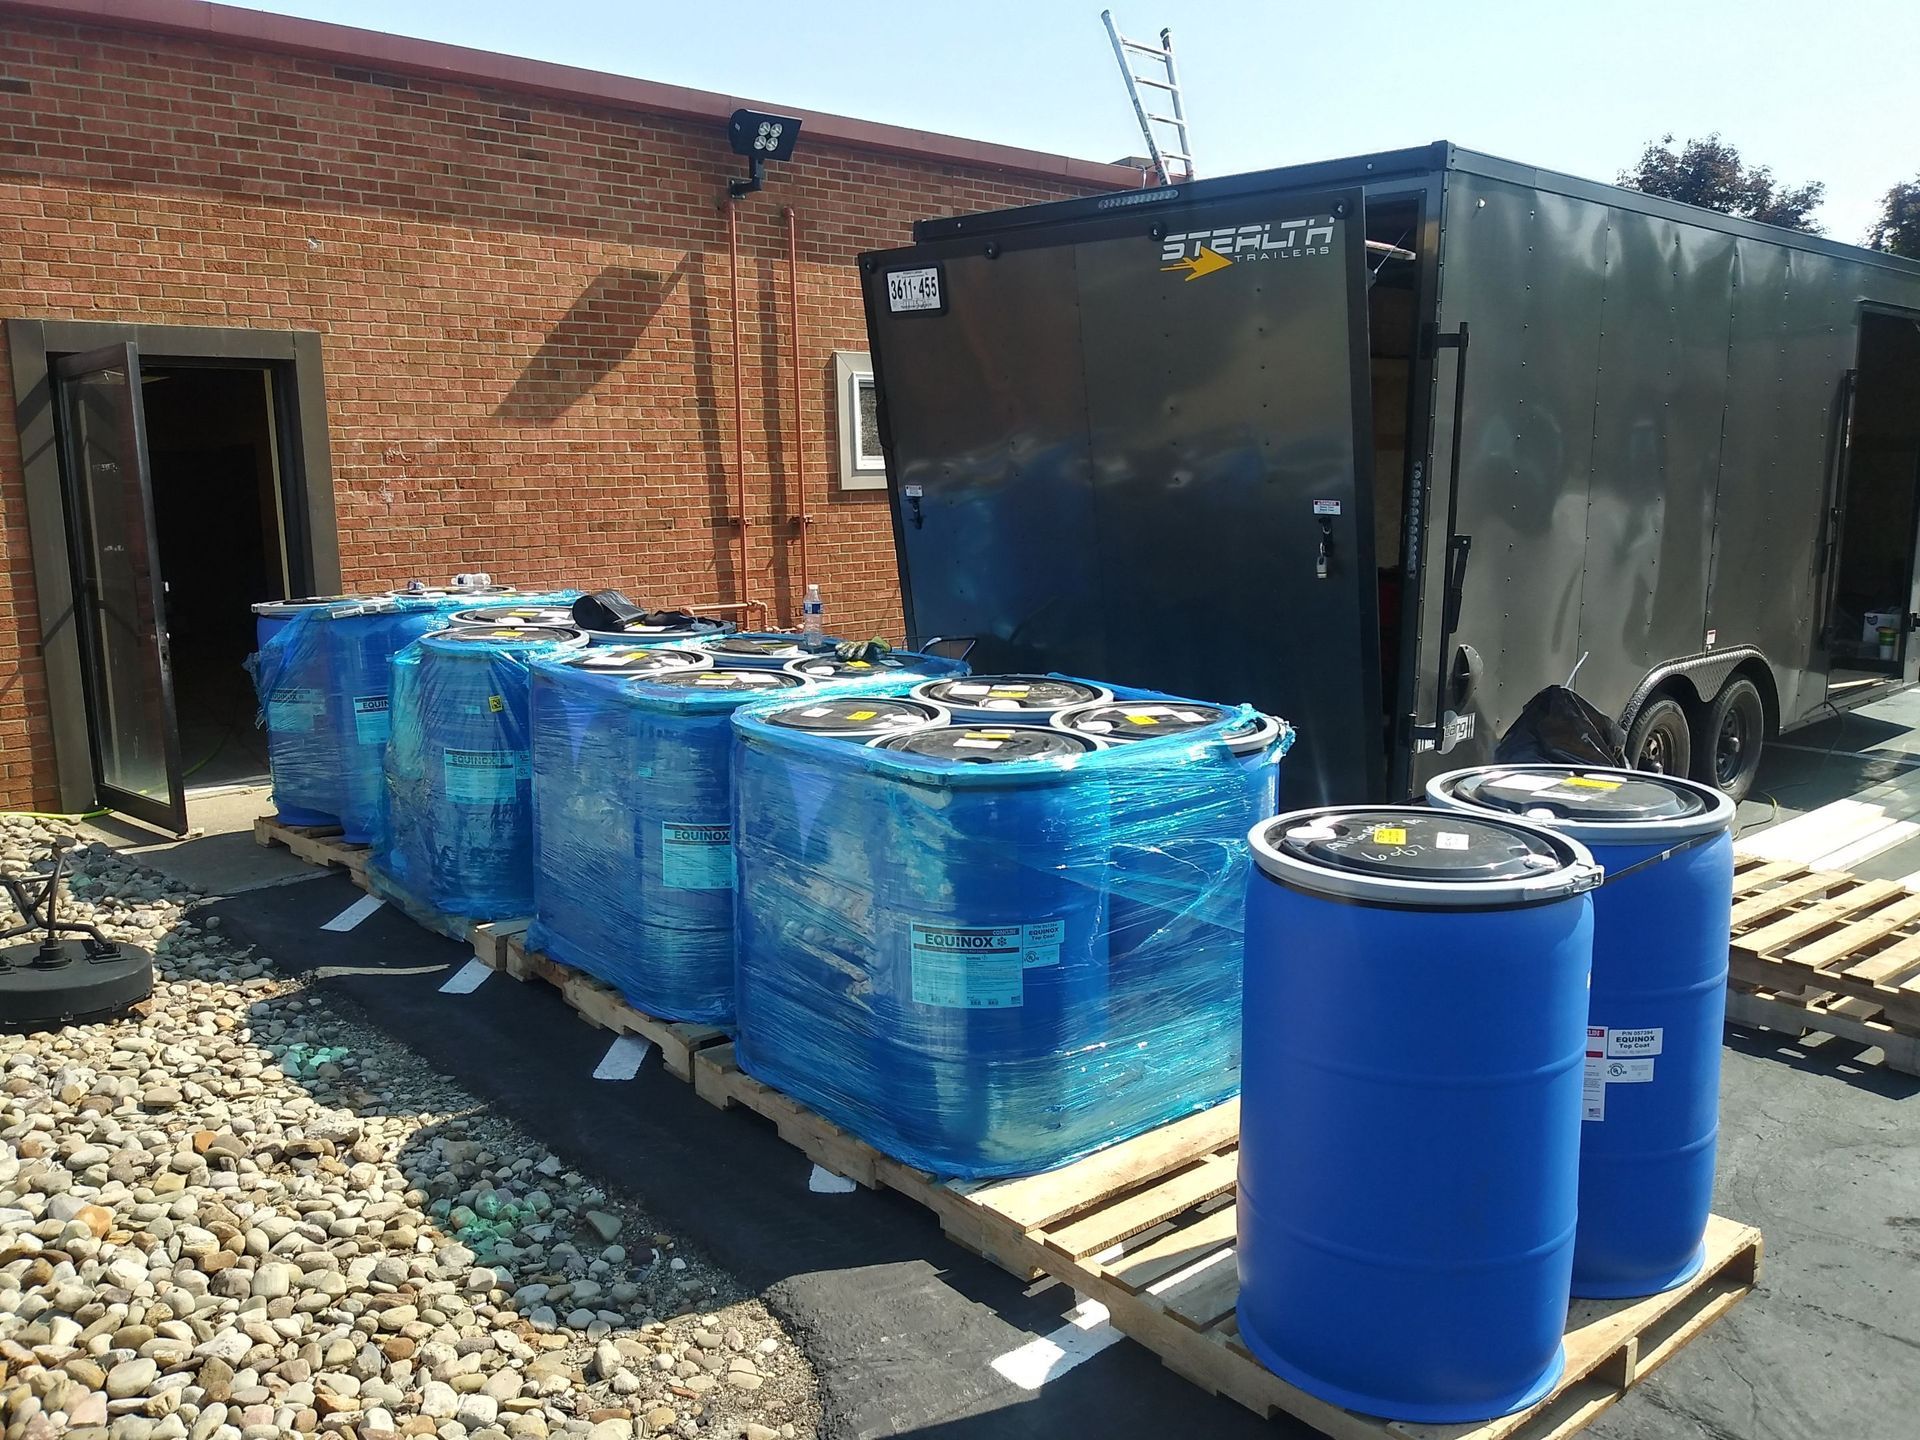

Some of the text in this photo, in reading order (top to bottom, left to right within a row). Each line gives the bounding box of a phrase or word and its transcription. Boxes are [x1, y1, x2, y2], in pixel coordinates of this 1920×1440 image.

[1161, 216, 1336, 261] STEALTH
[1234, 246, 1330, 263] TRAILERS
[452, 755, 497, 766] EQUINOX
[673, 830, 731, 841] EQUINOX
[1028, 927, 1059, 936] EQUINOX
[925, 933, 994, 948] EQUINOX
[1616, 1035, 1655, 1043] EQUINOX
